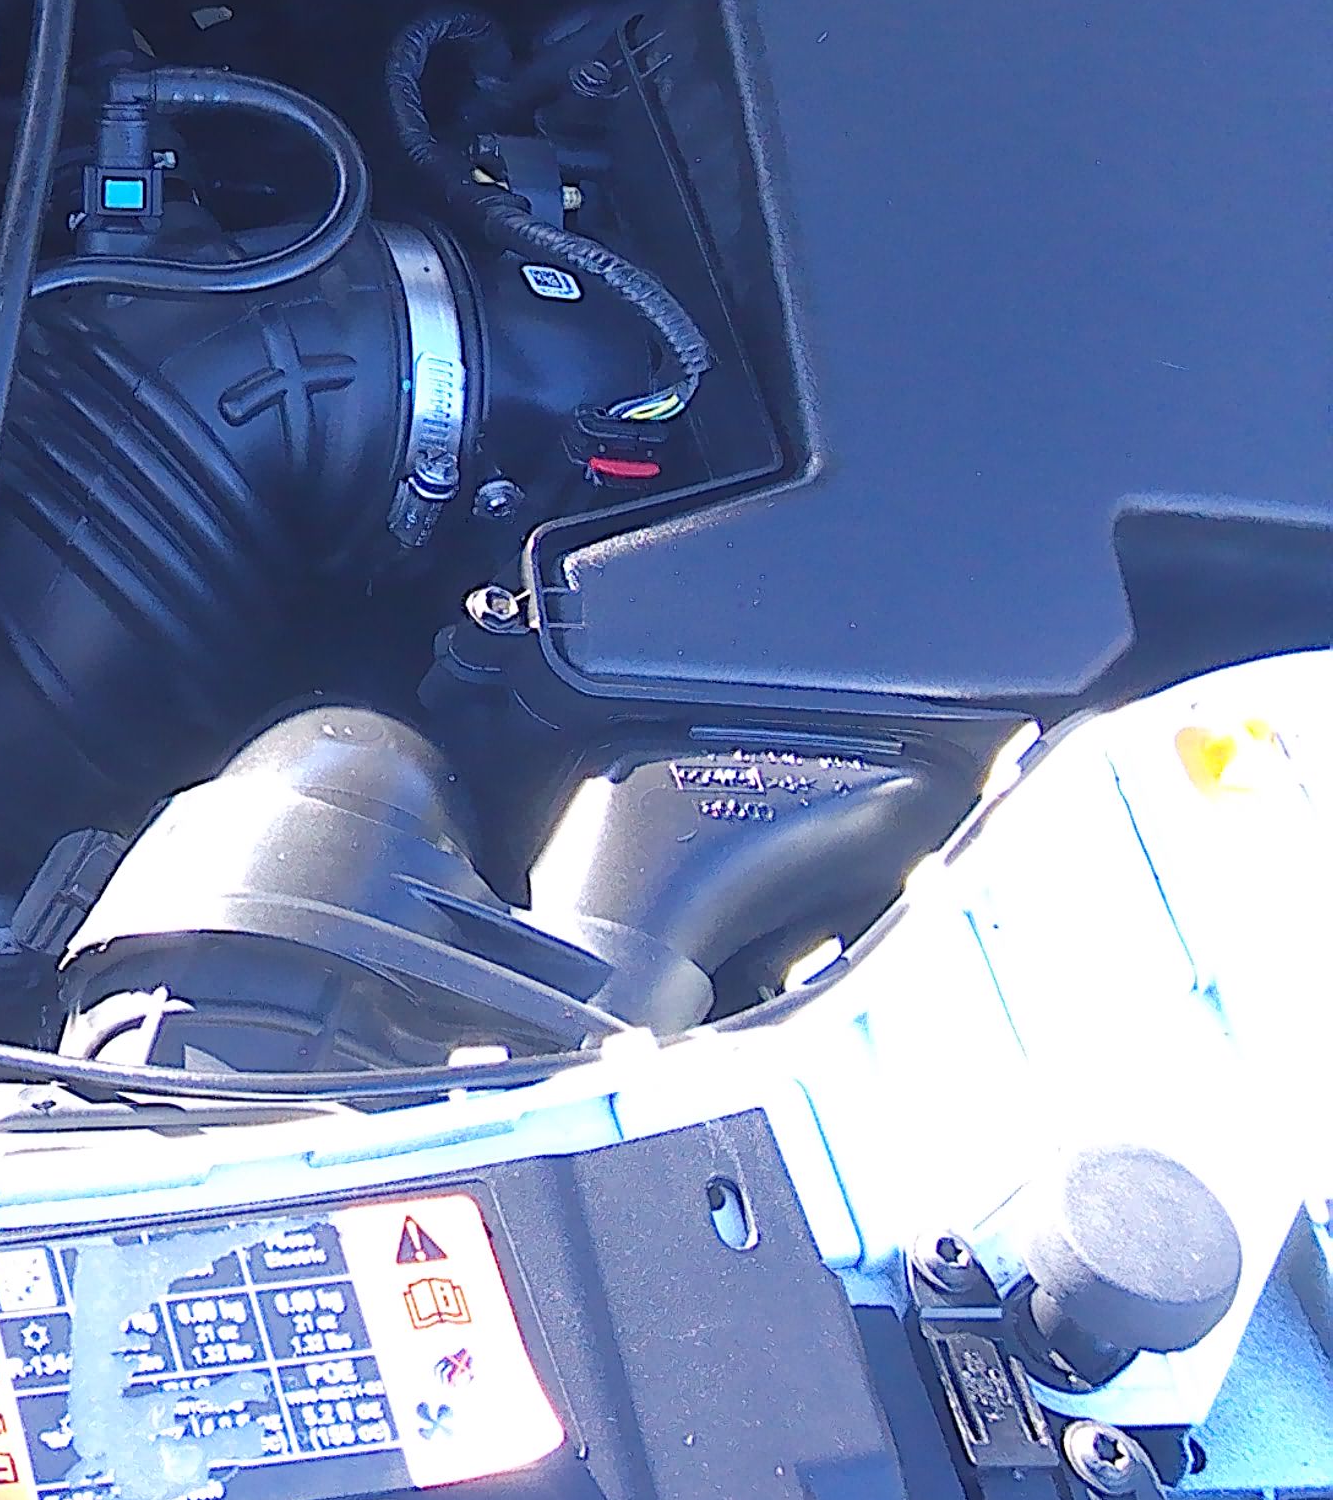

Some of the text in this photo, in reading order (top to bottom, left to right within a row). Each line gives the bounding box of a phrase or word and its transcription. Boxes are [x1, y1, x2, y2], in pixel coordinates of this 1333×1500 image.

[218, 1299, 248, 1324] kg
[316, 1288, 346, 1314] kg
[194, 1325, 216, 1344] 21
[293, 1314, 314, 1333] 21
[304, 1360, 358, 1387] POE
